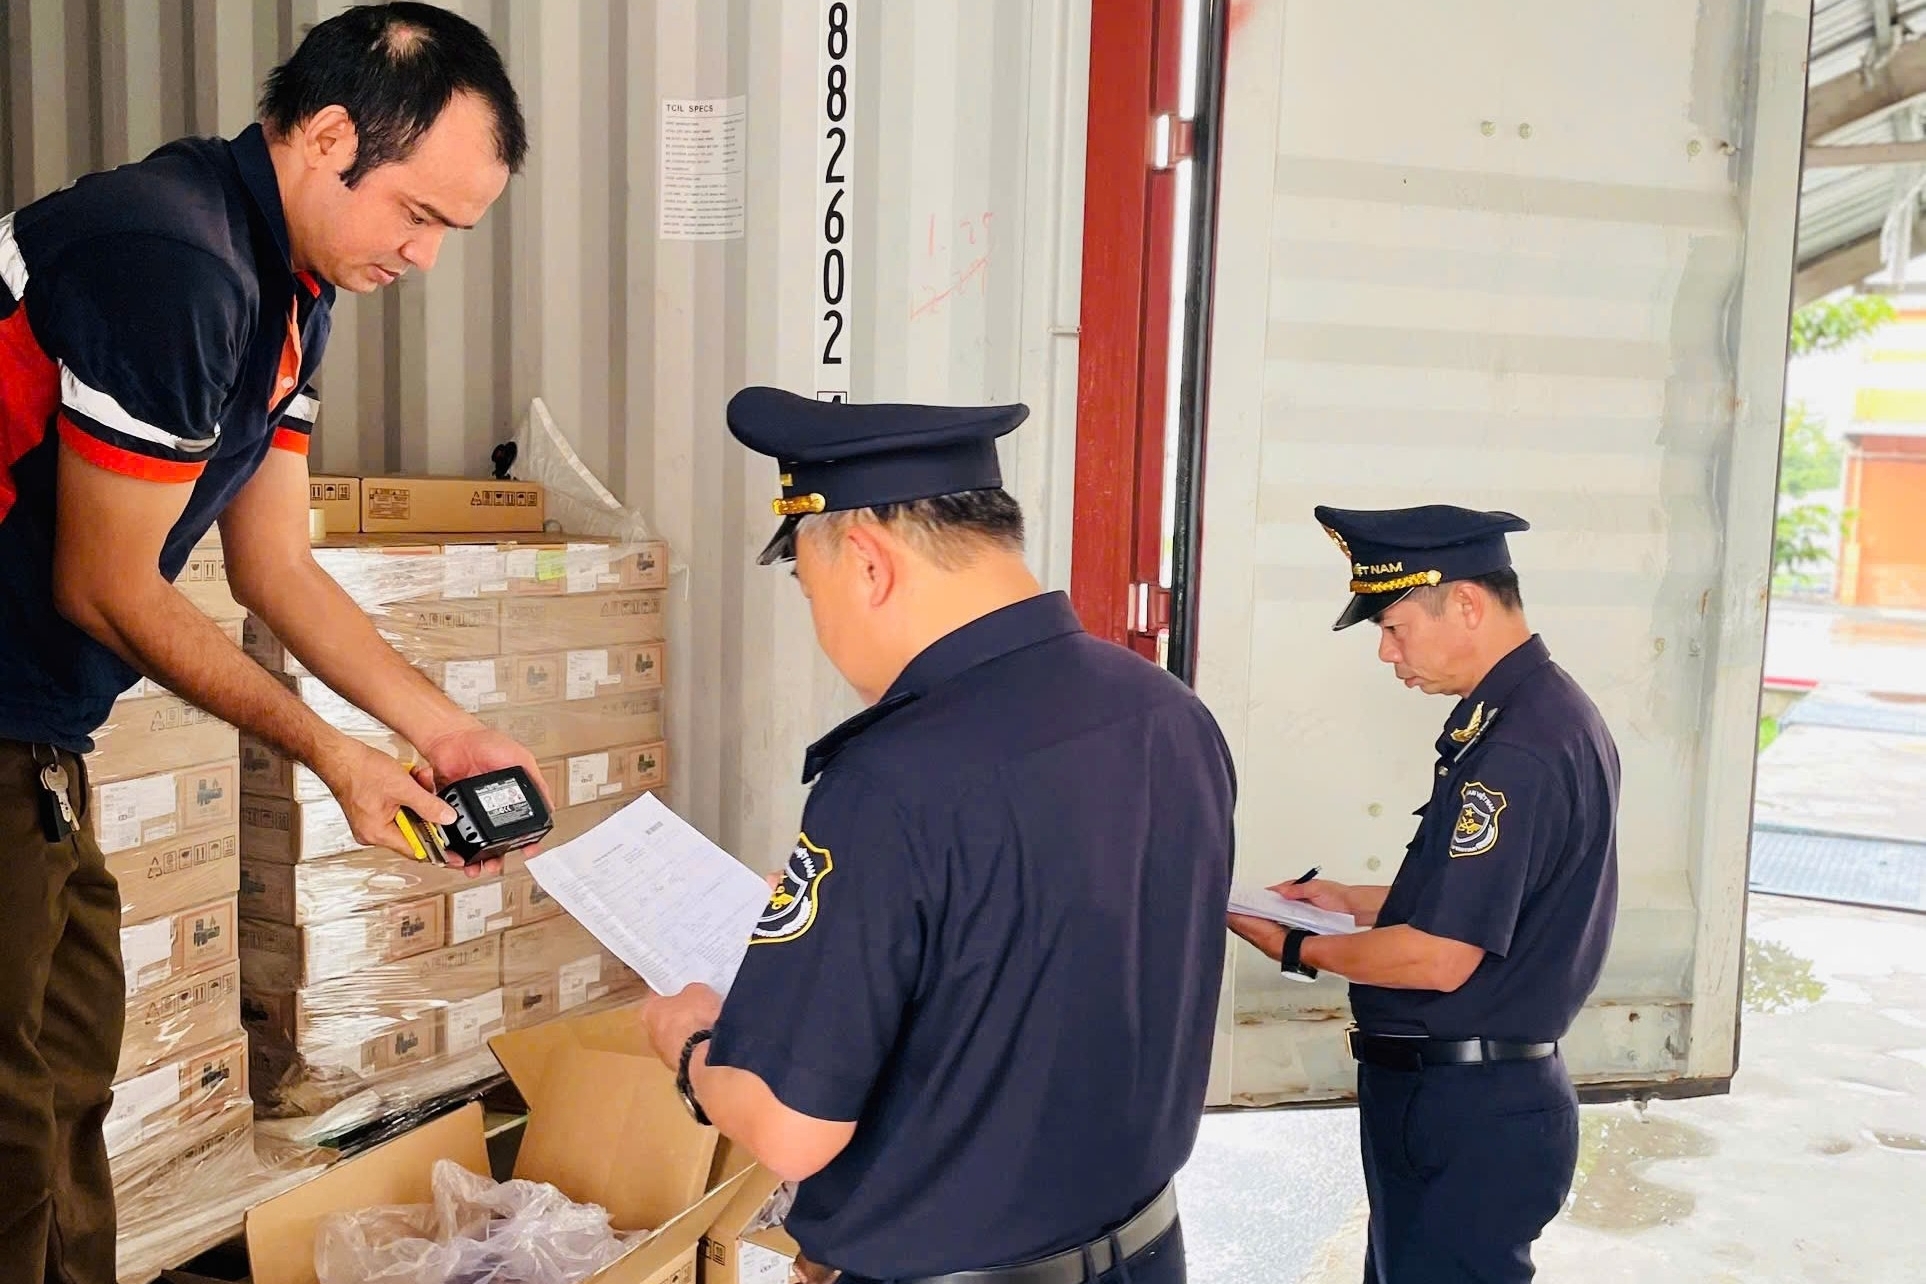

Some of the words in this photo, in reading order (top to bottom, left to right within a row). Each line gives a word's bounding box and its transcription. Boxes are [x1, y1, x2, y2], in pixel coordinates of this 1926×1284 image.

[688, 104, 714, 113] SPECS
[1370, 561, 1403, 574] NAM
[803, 858, 816, 878] NAM
